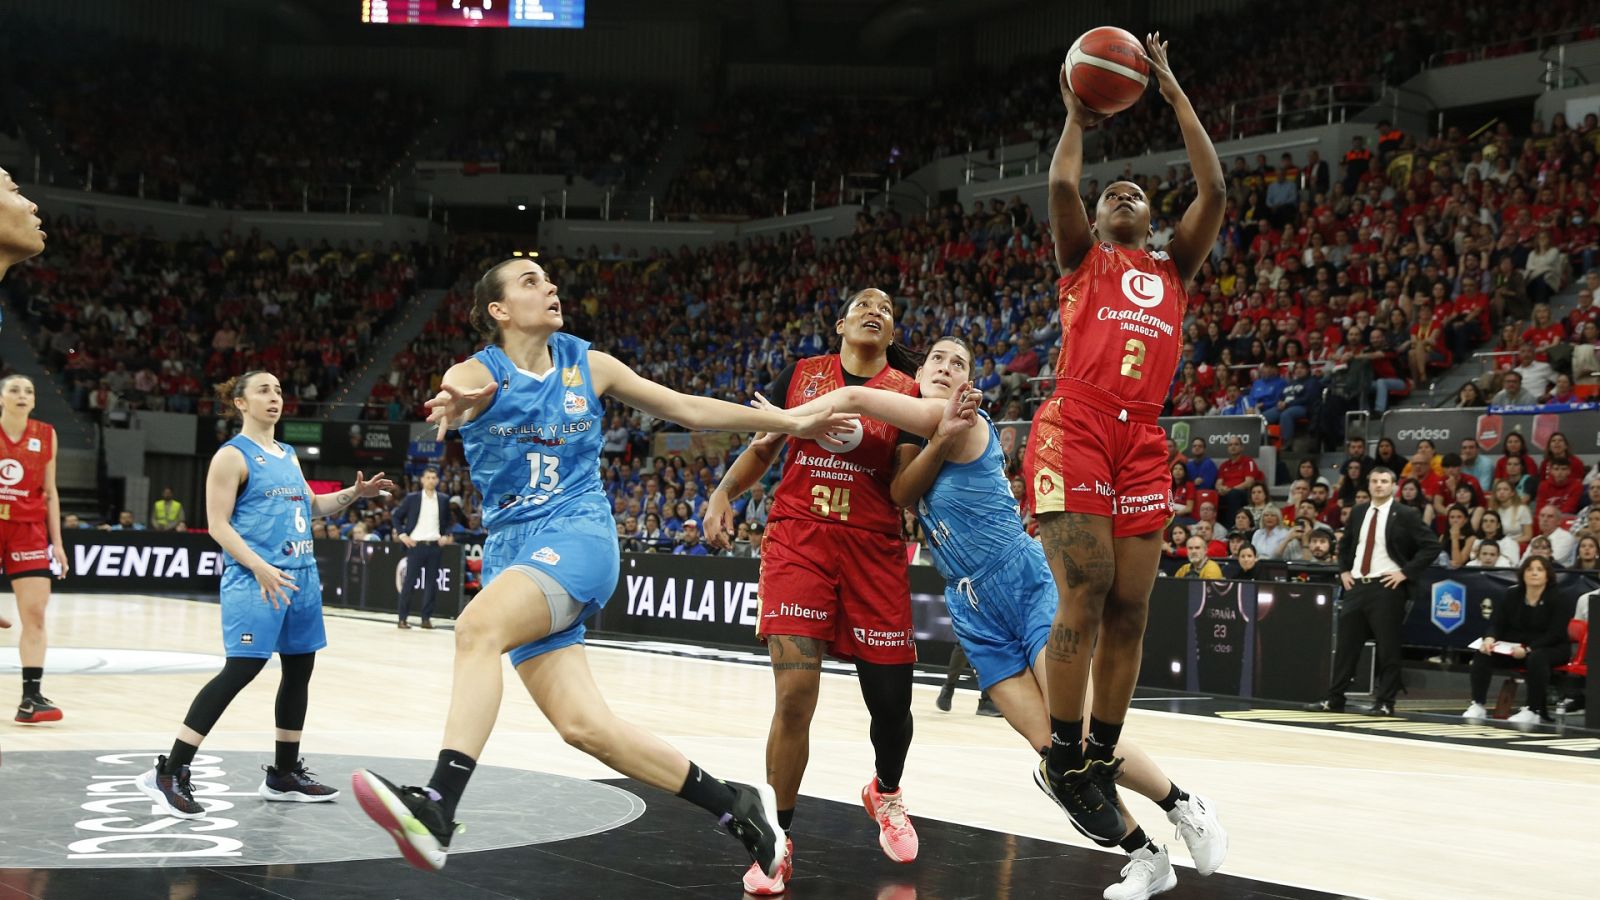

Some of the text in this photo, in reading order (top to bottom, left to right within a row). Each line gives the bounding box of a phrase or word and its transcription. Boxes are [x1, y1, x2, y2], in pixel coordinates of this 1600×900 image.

[1097, 306, 1174, 337] Casademont
[1120, 338, 1146, 380] 2
[489, 418, 593, 438] CASTILLA Y LEÓN
[1397, 427, 1450, 441] endesa
[526, 452, 560, 492] 13
[810, 469, 854, 482] ZARAGOZA
[810, 484, 851, 521] 34
[1120, 493, 1164, 504] Zaragoza
[1121, 502, 1166, 515] DEPORTE
[295, 506, 306, 533] 6
[75, 544, 190, 578] VENTA
[626, 575, 655, 617] YA
[657, 577, 677, 619] A
[682, 578, 716, 623] LA
[780, 602, 828, 621] hiberus
[868, 629, 905, 640] Zaragoza
[1213, 624, 1227, 638] 23
[868, 638, 905, 647] DEPORTE
